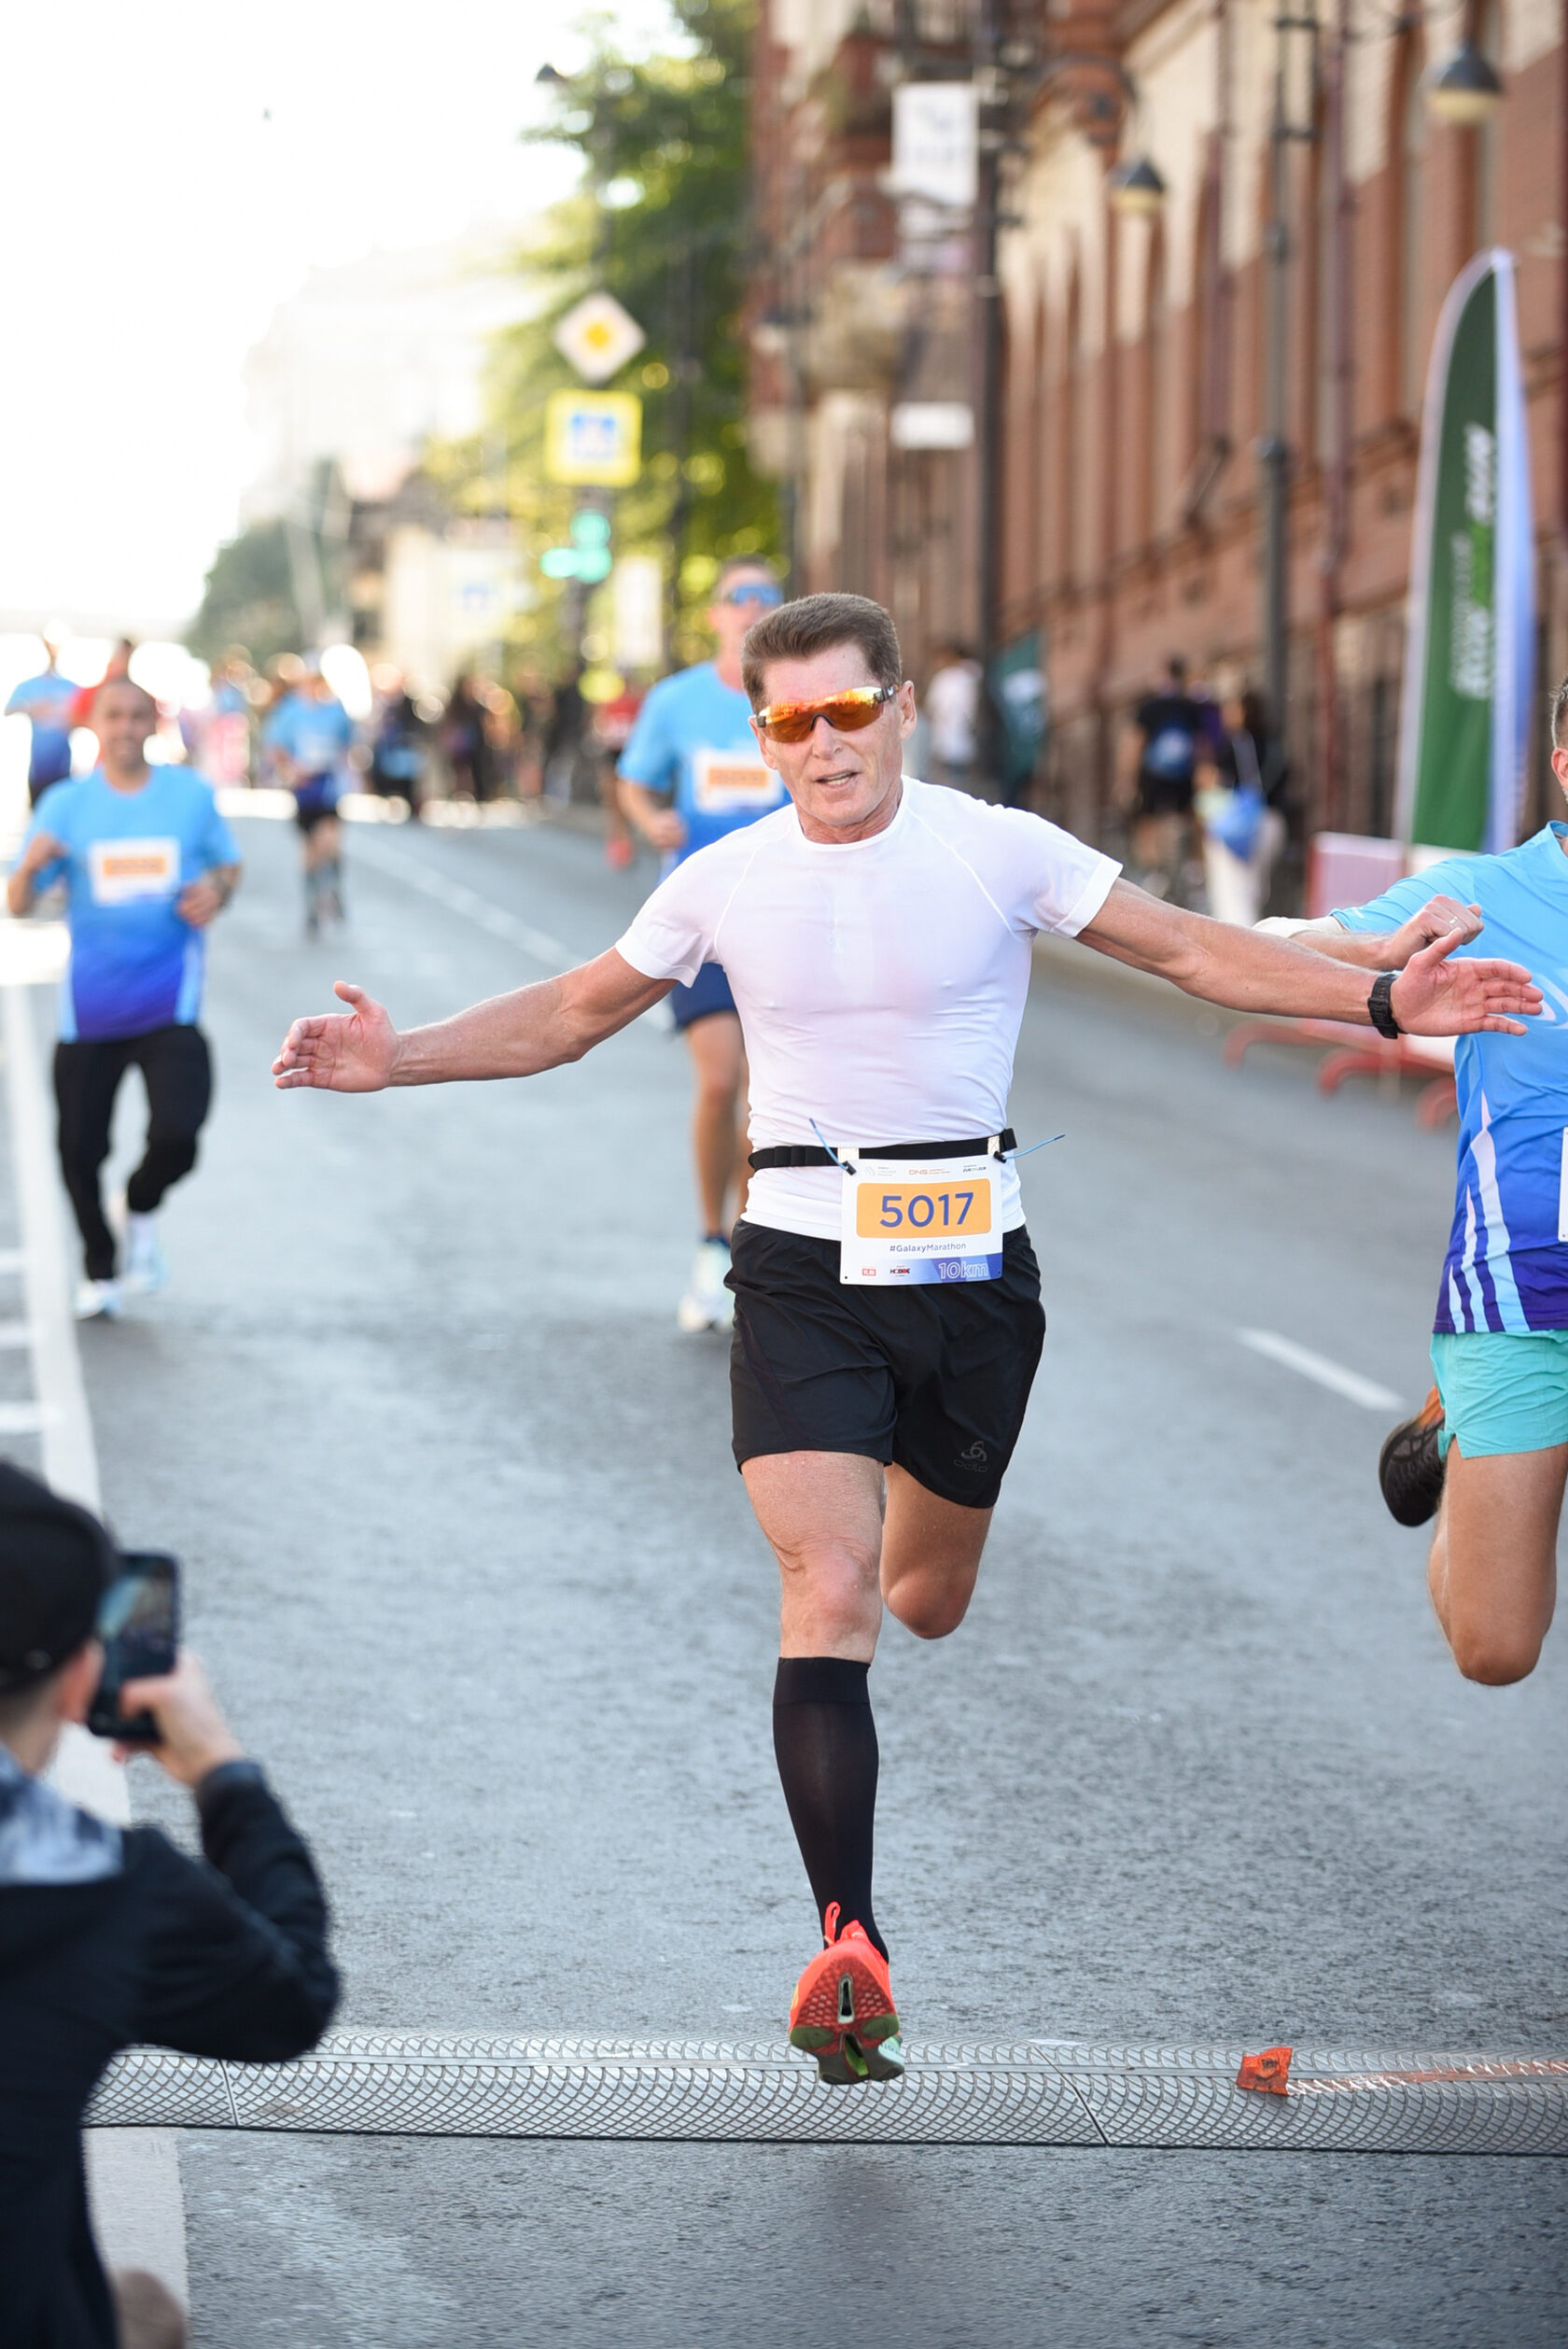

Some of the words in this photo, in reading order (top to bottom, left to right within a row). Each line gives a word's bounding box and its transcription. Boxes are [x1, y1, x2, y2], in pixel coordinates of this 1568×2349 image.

[879, 1191, 973, 1228] 5017
[889, 1242, 967, 1252] #GalaxyMarathon
[938, 1260, 988, 1279] 10km
